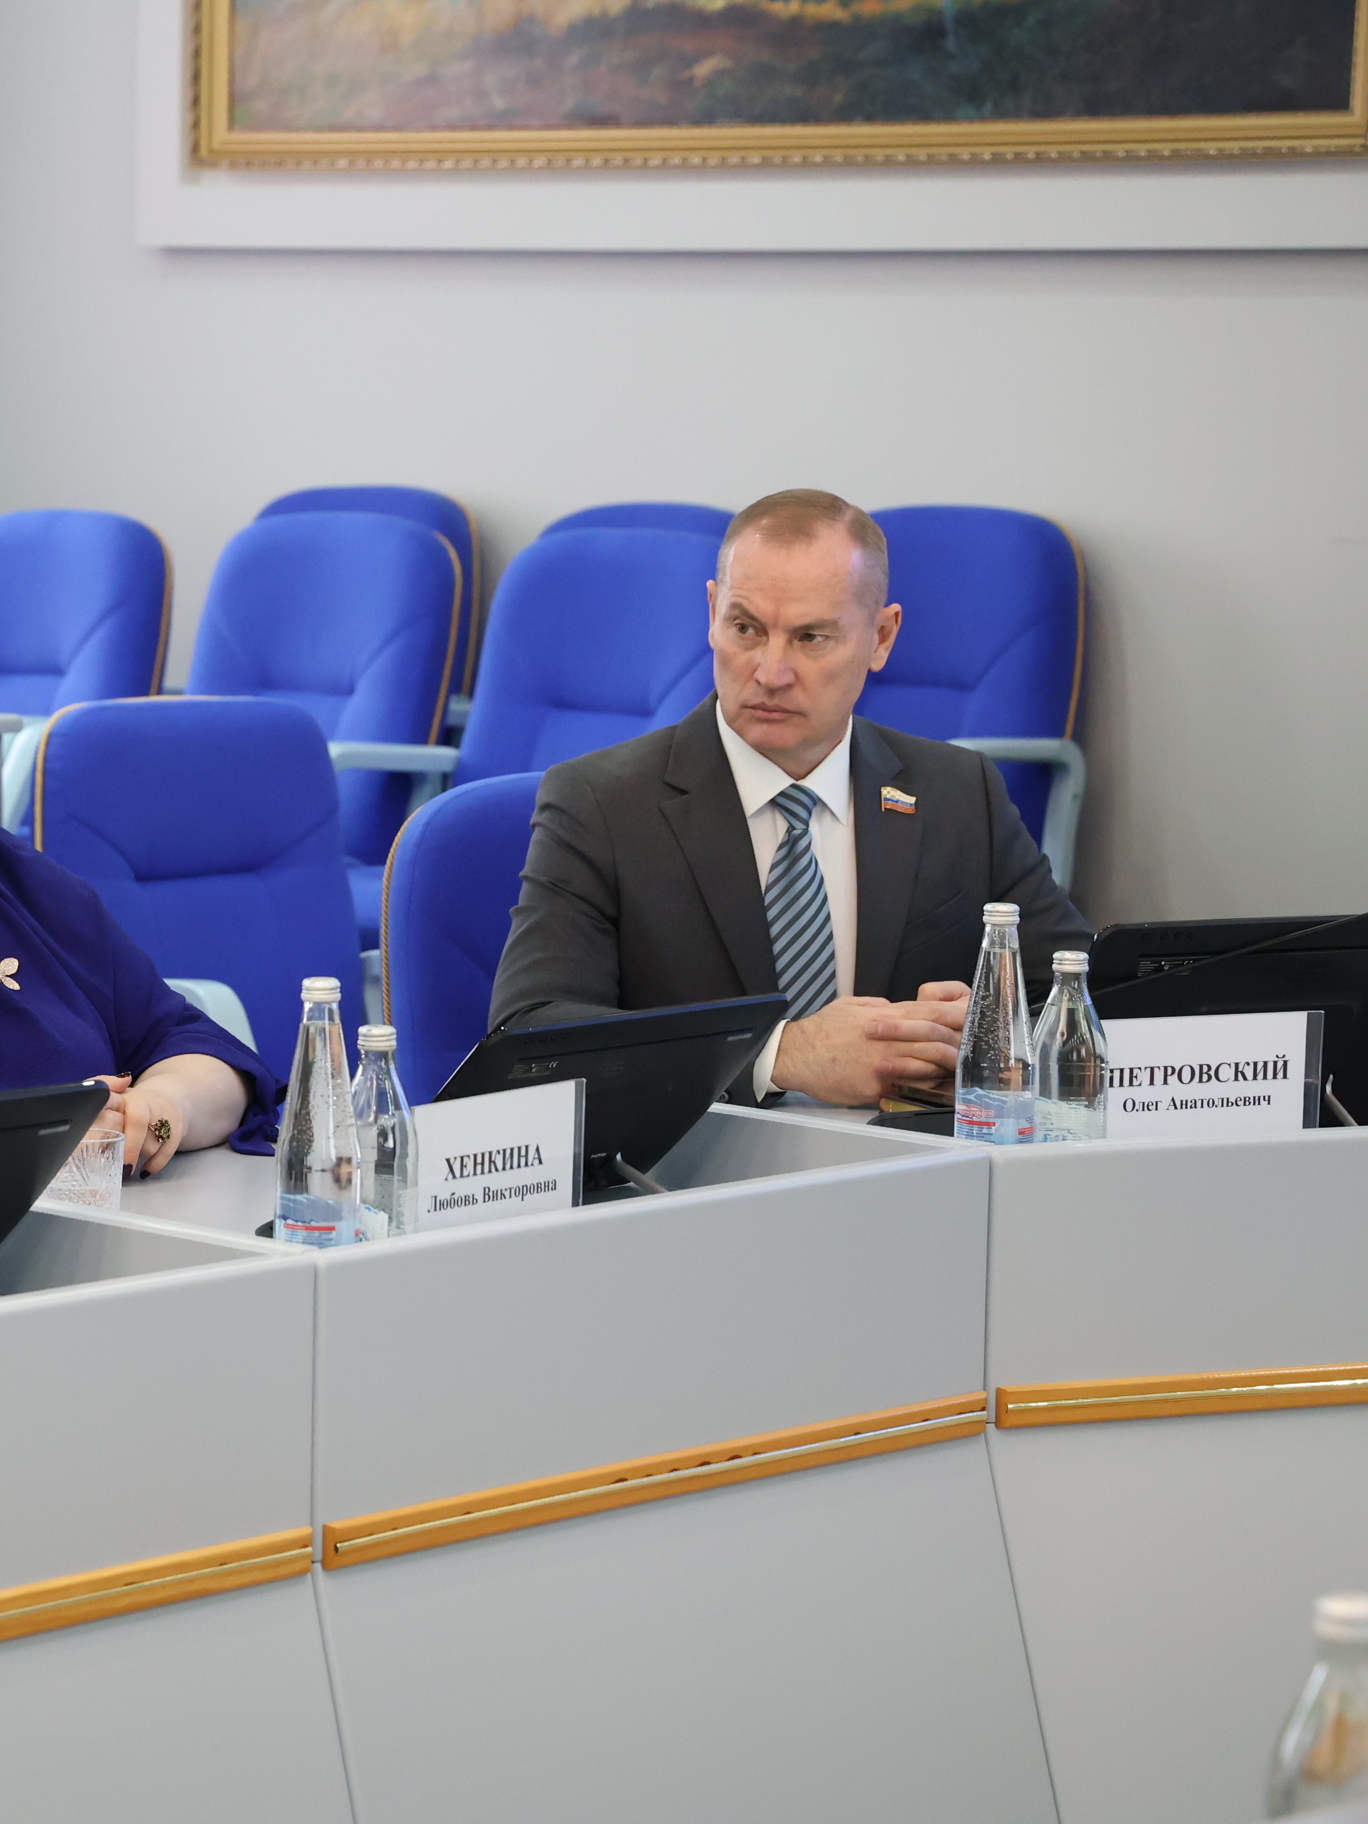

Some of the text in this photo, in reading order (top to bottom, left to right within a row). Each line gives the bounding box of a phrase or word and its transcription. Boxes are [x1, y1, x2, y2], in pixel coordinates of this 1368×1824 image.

[1108, 1054, 1290, 1089] ПЕТРОВСКИЙ
[1122, 1094, 1272, 1113] Олег Анатольевич
[444, 1143, 544, 1181] ХЕНКИНА
[427, 1178, 557, 1214] Любовь Викторовна
